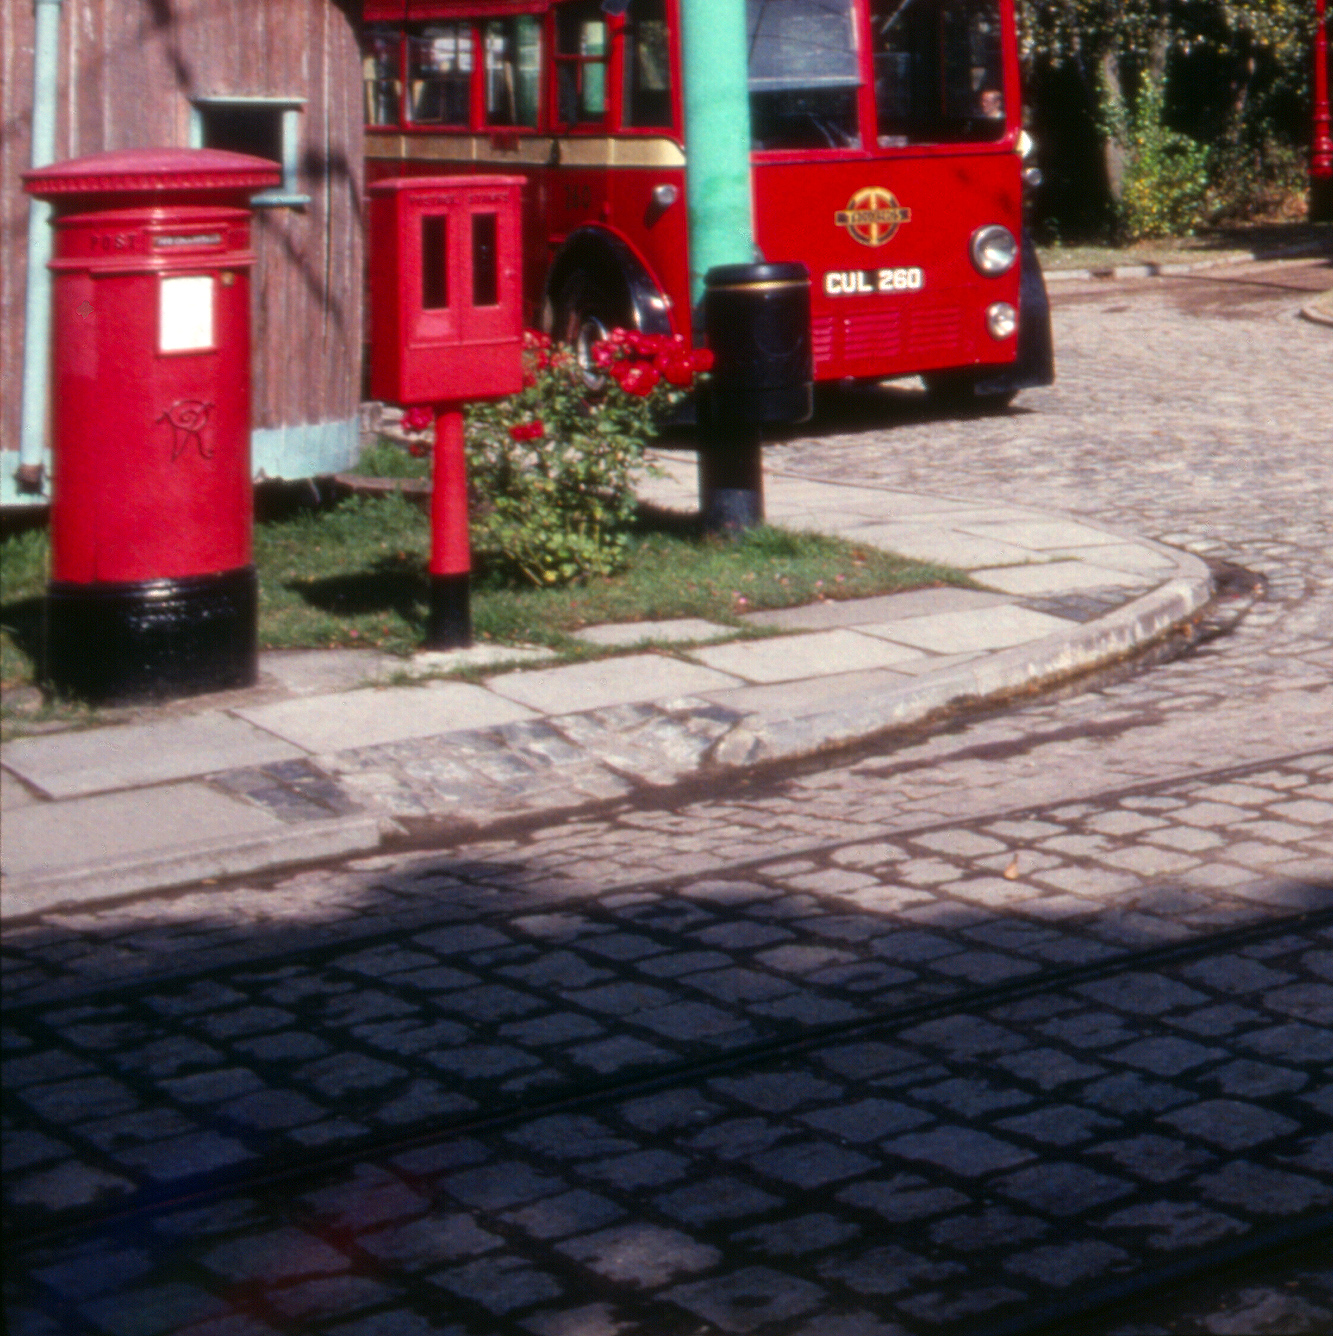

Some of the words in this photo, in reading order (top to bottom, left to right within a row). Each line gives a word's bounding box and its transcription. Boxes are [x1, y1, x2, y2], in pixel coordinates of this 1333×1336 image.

[89, 231, 138, 251] POST
[825, 270, 873, 294] CUL
[878, 267, 922, 291] 260
